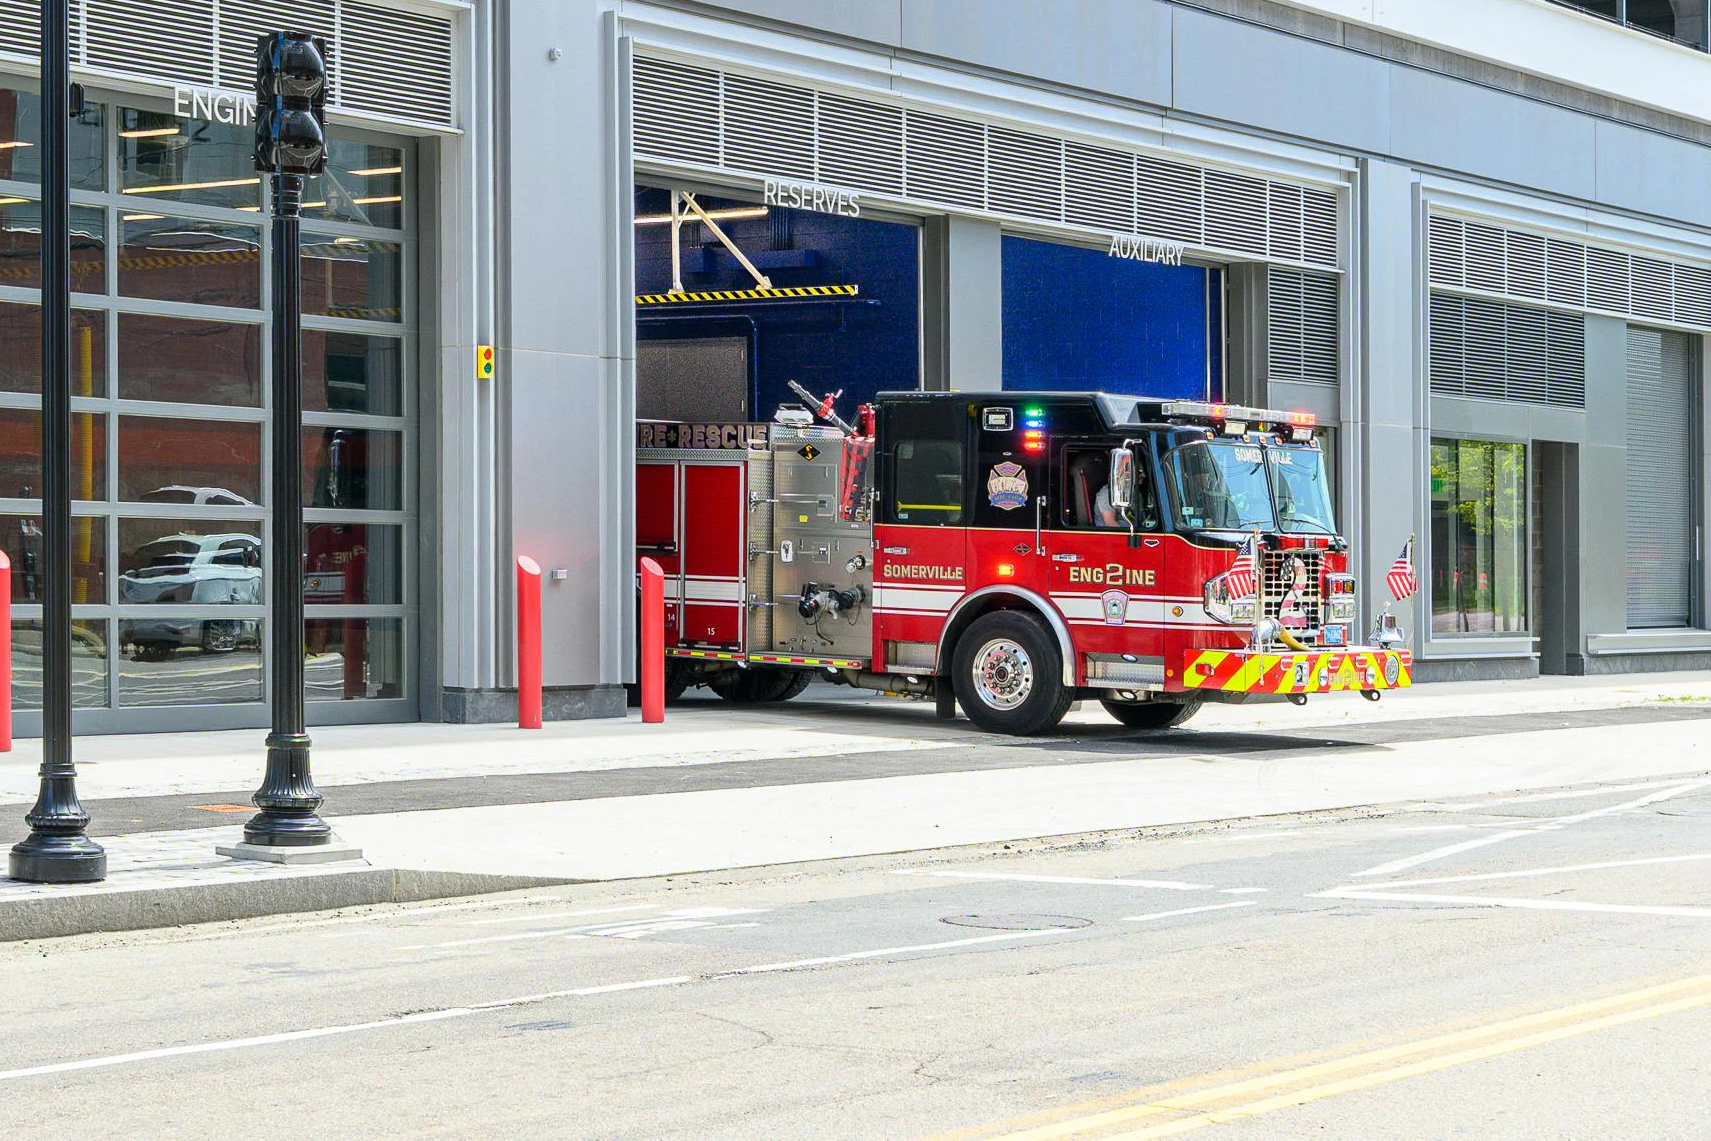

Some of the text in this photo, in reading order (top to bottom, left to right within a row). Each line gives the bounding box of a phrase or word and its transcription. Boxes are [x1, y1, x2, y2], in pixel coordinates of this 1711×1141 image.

[174, 87, 257, 128] ENGIN
[764, 180, 860, 217] RESERVES
[1109, 235, 1185, 266] AUXILIARY
[637, 424, 767, 450] RE RESCUE
[883, 563, 964, 581] SOMERVILLE
[667, 613, 676, 622] 14
[707, 627, 716, 636] 15
